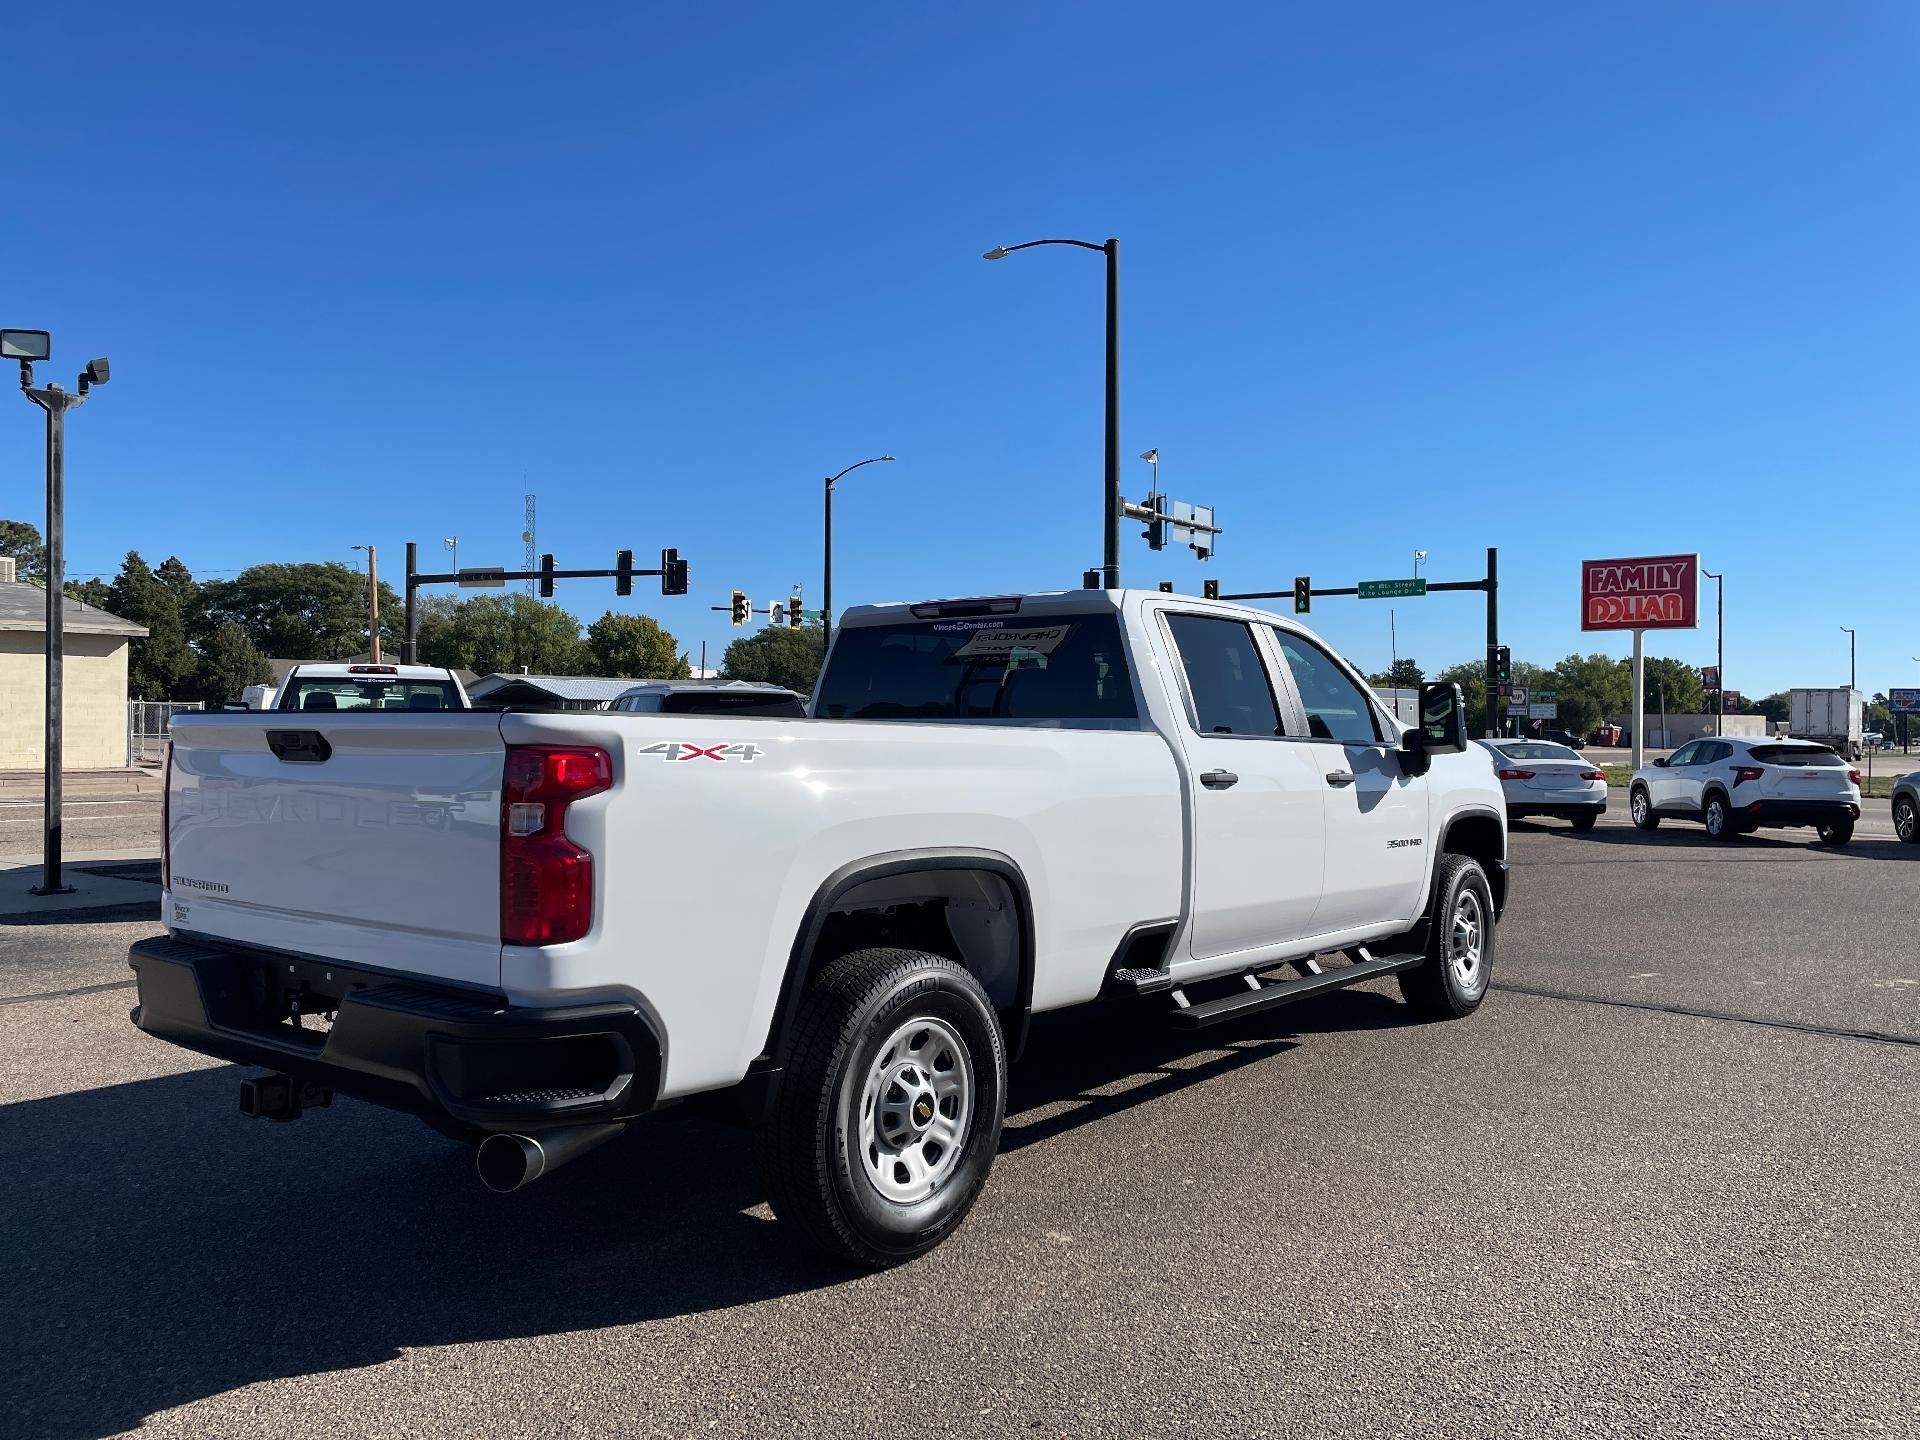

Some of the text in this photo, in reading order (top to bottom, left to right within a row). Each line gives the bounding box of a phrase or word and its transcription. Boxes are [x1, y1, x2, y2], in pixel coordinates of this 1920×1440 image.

[1589, 562, 1688, 593] FAMILY
[1588, 593, 1683, 623] DOLLAR
[1386, 838, 1422, 849] 3500 HD
[172, 875, 229, 894] SILVERADO
